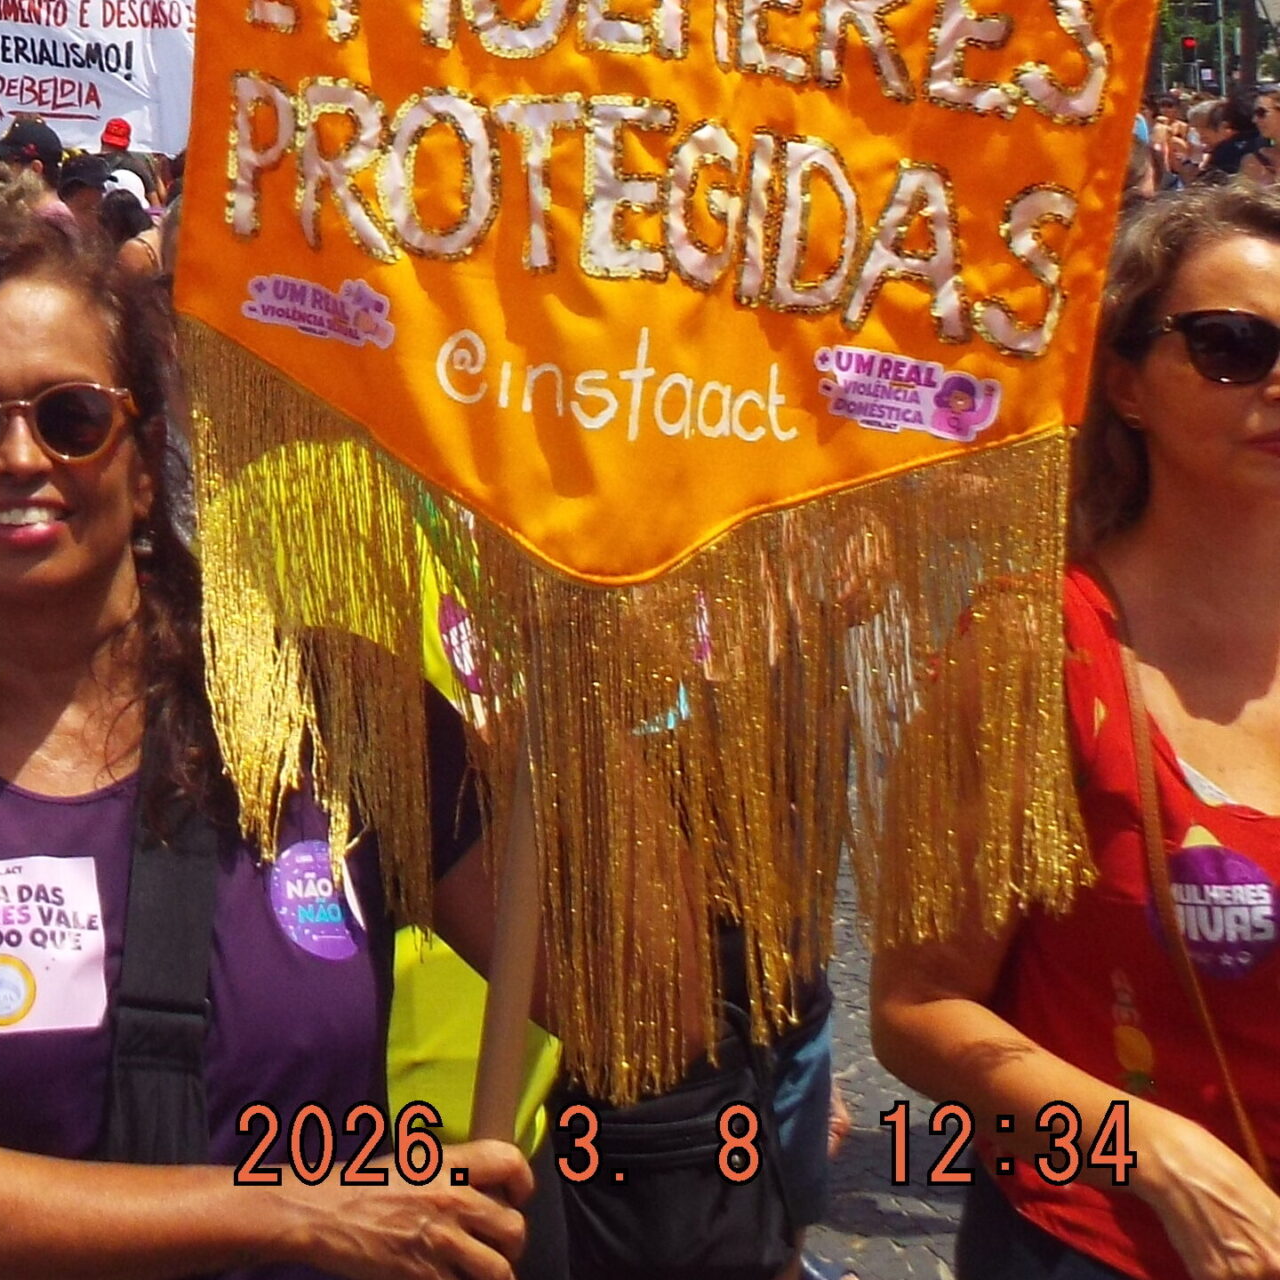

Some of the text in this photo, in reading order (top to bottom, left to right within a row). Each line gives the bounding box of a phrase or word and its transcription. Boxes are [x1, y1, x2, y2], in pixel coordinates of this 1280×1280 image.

[225, 71, 1079, 360] PROTEGIDAS
[273, 280, 307, 305] UM
[835, 351, 875, 377] UM
[878, 358, 938, 388] REAL
[844, 379, 920, 404] VIOLÊNCIA
[17, 884, 65, 907] DAS
[286, 872, 333, 899] NÃO
[37, 906, 99, 931] VALE
[297, 898, 343, 924] NÃO
[30, 928, 82, 951] QUE
